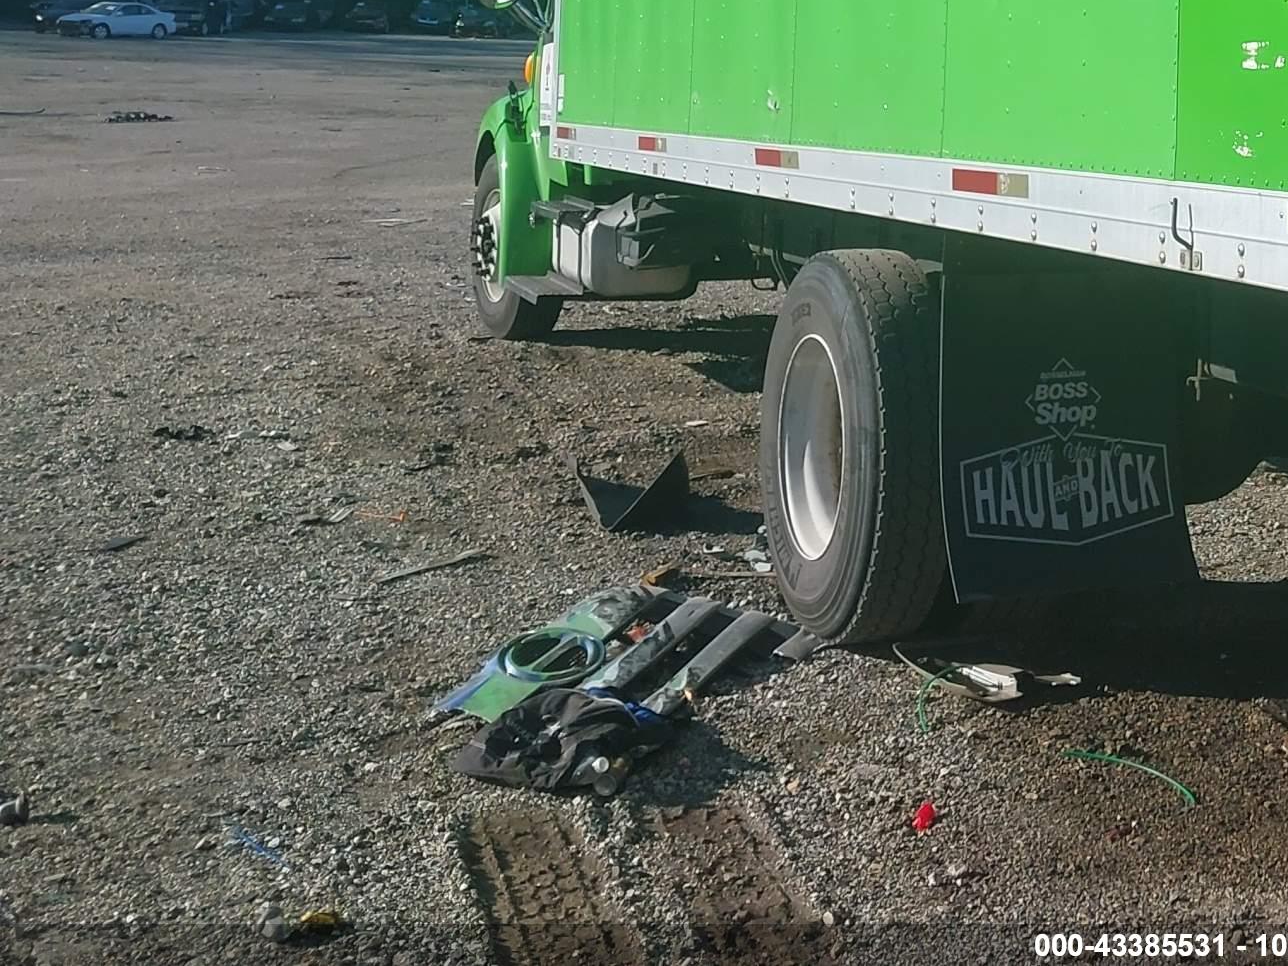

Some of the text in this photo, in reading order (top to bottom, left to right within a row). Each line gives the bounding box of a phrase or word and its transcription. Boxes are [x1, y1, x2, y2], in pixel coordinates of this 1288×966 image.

[1035, 382, 1088, 401] BOSS
[1035, 402, 1097, 427] Shop
[973, 450, 1160, 531] HAUL AND BACK
